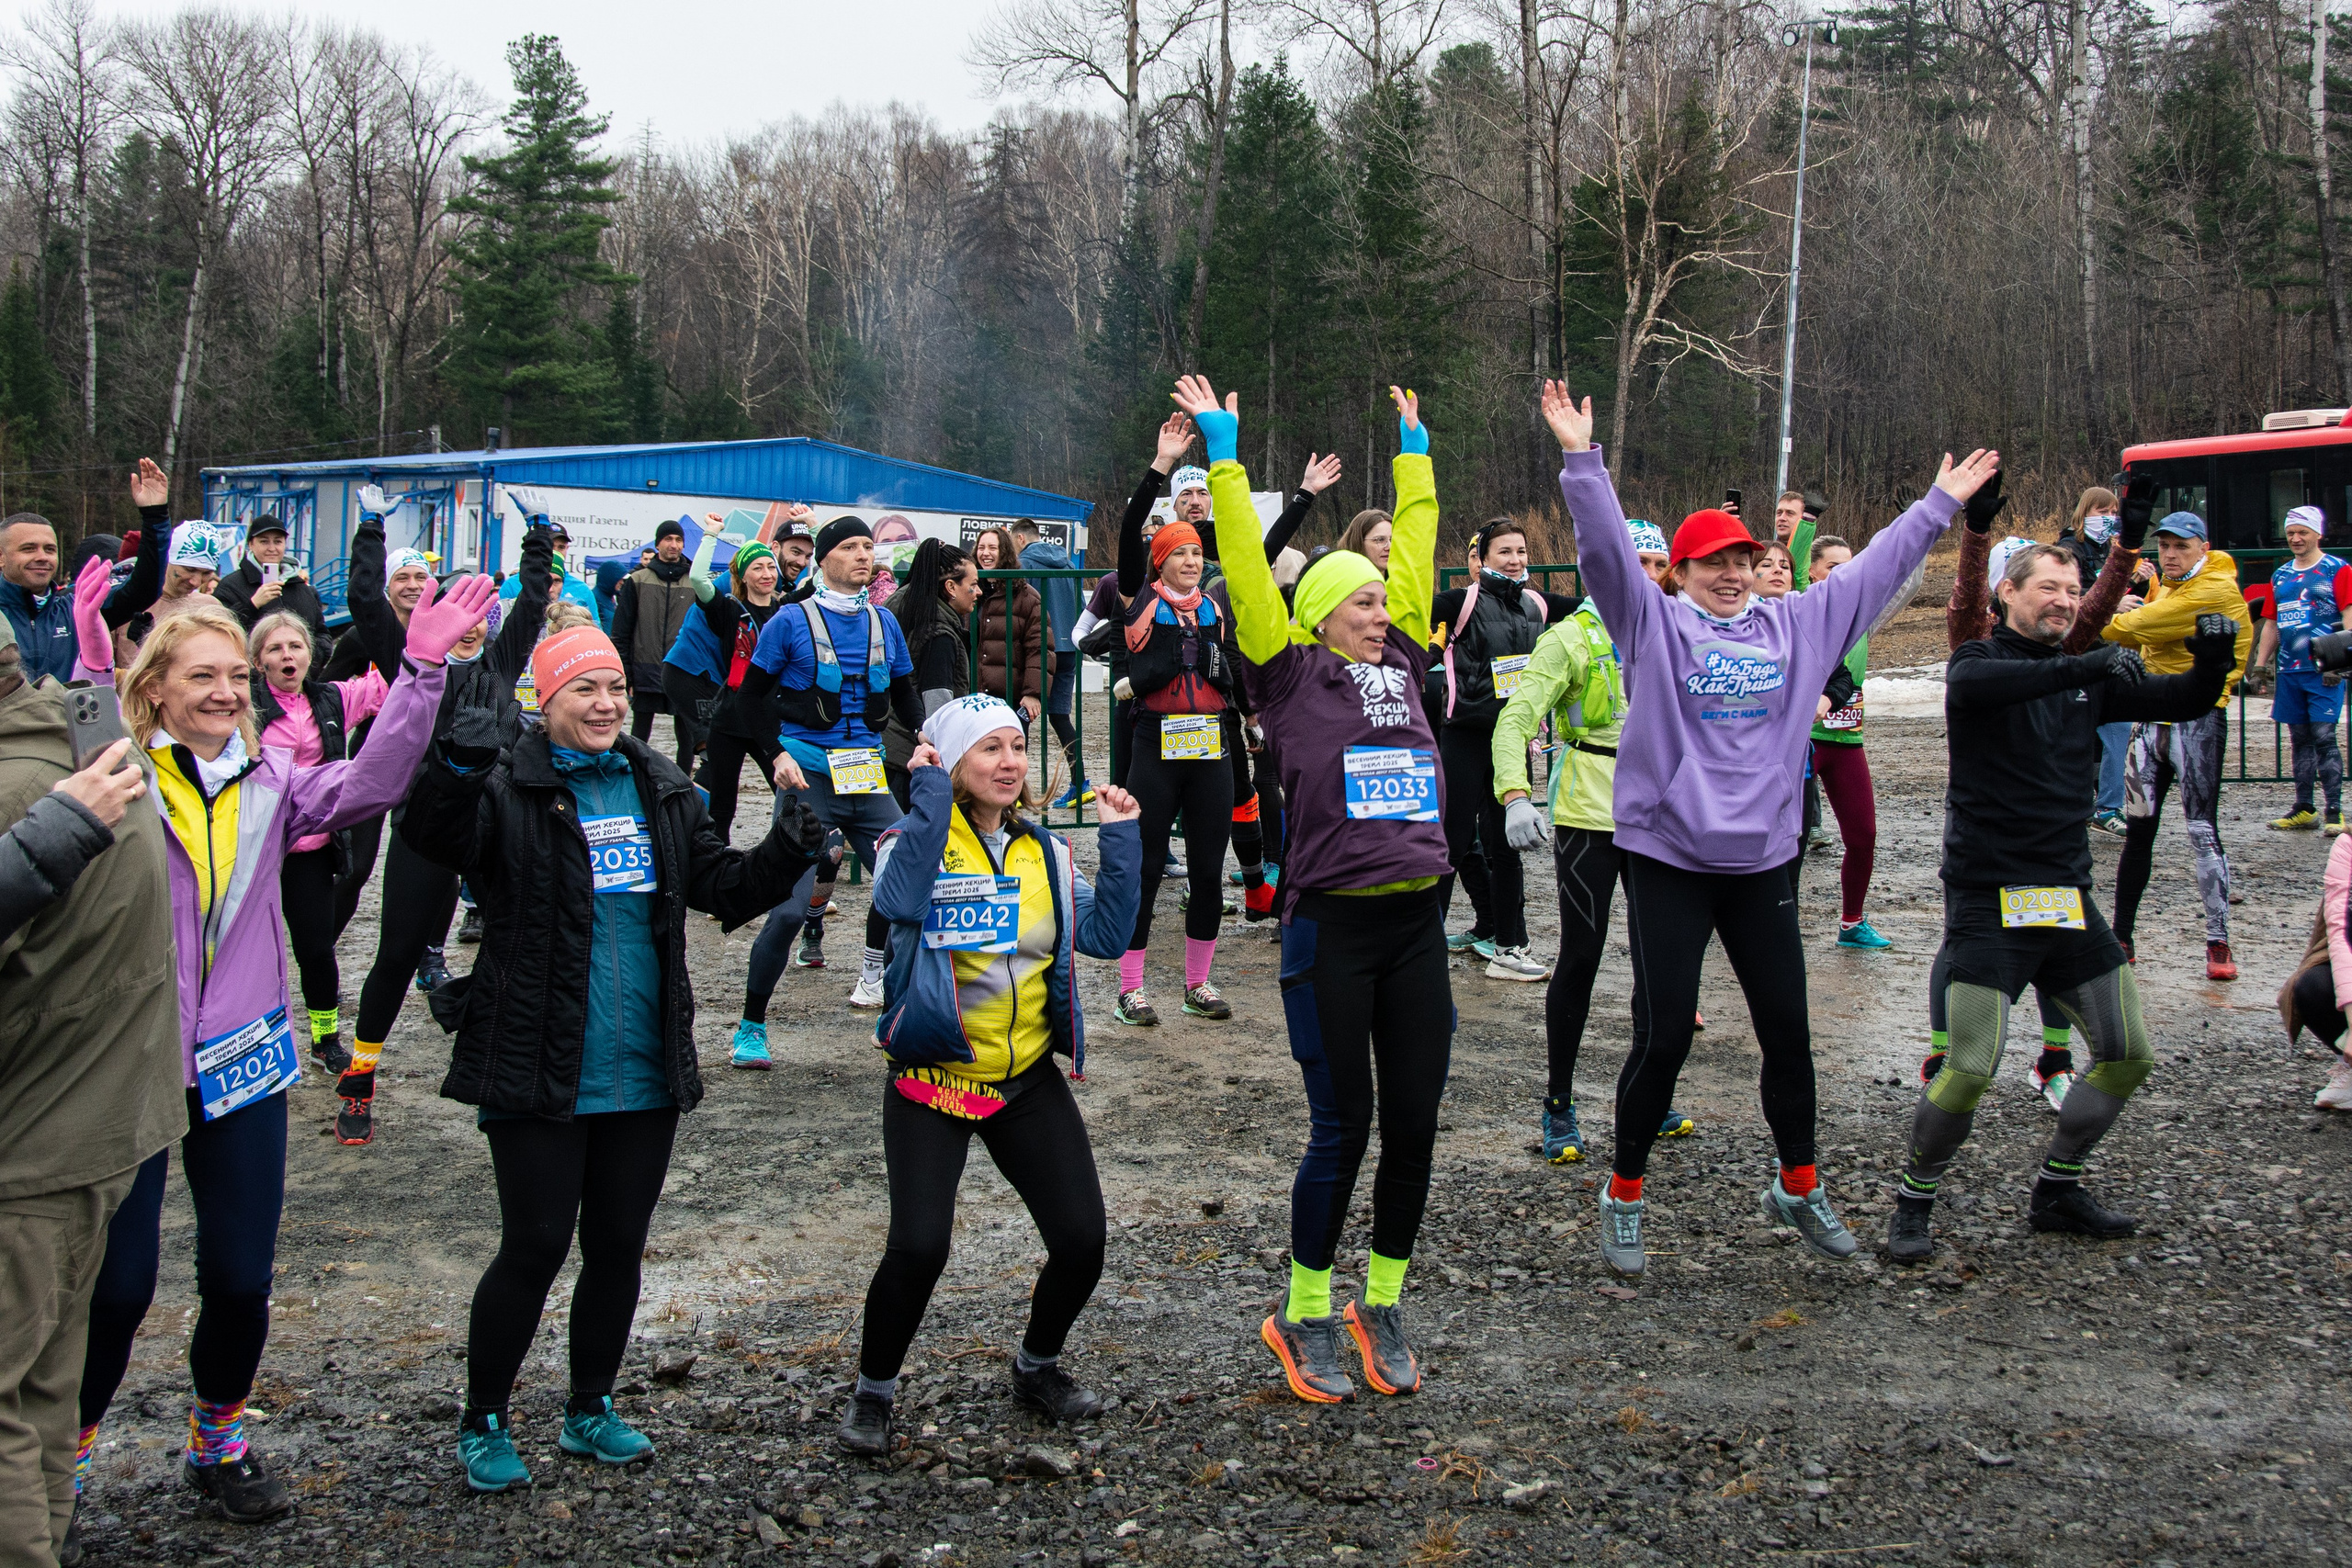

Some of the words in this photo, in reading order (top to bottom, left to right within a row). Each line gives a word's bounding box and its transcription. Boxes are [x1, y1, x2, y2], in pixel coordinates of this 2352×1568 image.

[589, 514, 628, 526] Газеты
[569, 536, 642, 550] ельская
[2279, 610, 2307, 621] 12005
[1706, 652, 1777, 680] #НеБудь
[1687, 673, 1784, 697] КакГриша
[1363, 702, 1409, 716] ХЕХЦИ
[1701, 710, 1729, 719] БЕГИ
[1731, 710, 1738, 718] С
[1741, 708, 1768, 718] НАМИ
[1165, 732, 1218, 749] 02002
[835, 766, 883, 783] 02003
[1356, 777, 1429, 800] 12033
[603, 818, 631, 829] ХЕХЦИР
[603, 828, 621, 836] 2025
[590, 846, 652, 872] 2035
[965, 878, 991, 887] ХЕХЦИР
[2007, 890, 2077, 911] 02058
[934, 905, 1011, 929] 12042
[199, 1039, 237, 1063] ВЕСЕННИЙ
[238, 1021, 263, 1041] ХЕХЦИР
[215, 1046, 237, 1063] ТРЕЙЛ
[239, 1036, 254, 1050] 2025
[215, 1040, 286, 1093] 12021
[937, 1086, 965, 1100] ВСЕМ
[932, 1096, 967, 1112] БЕГАТЬ
